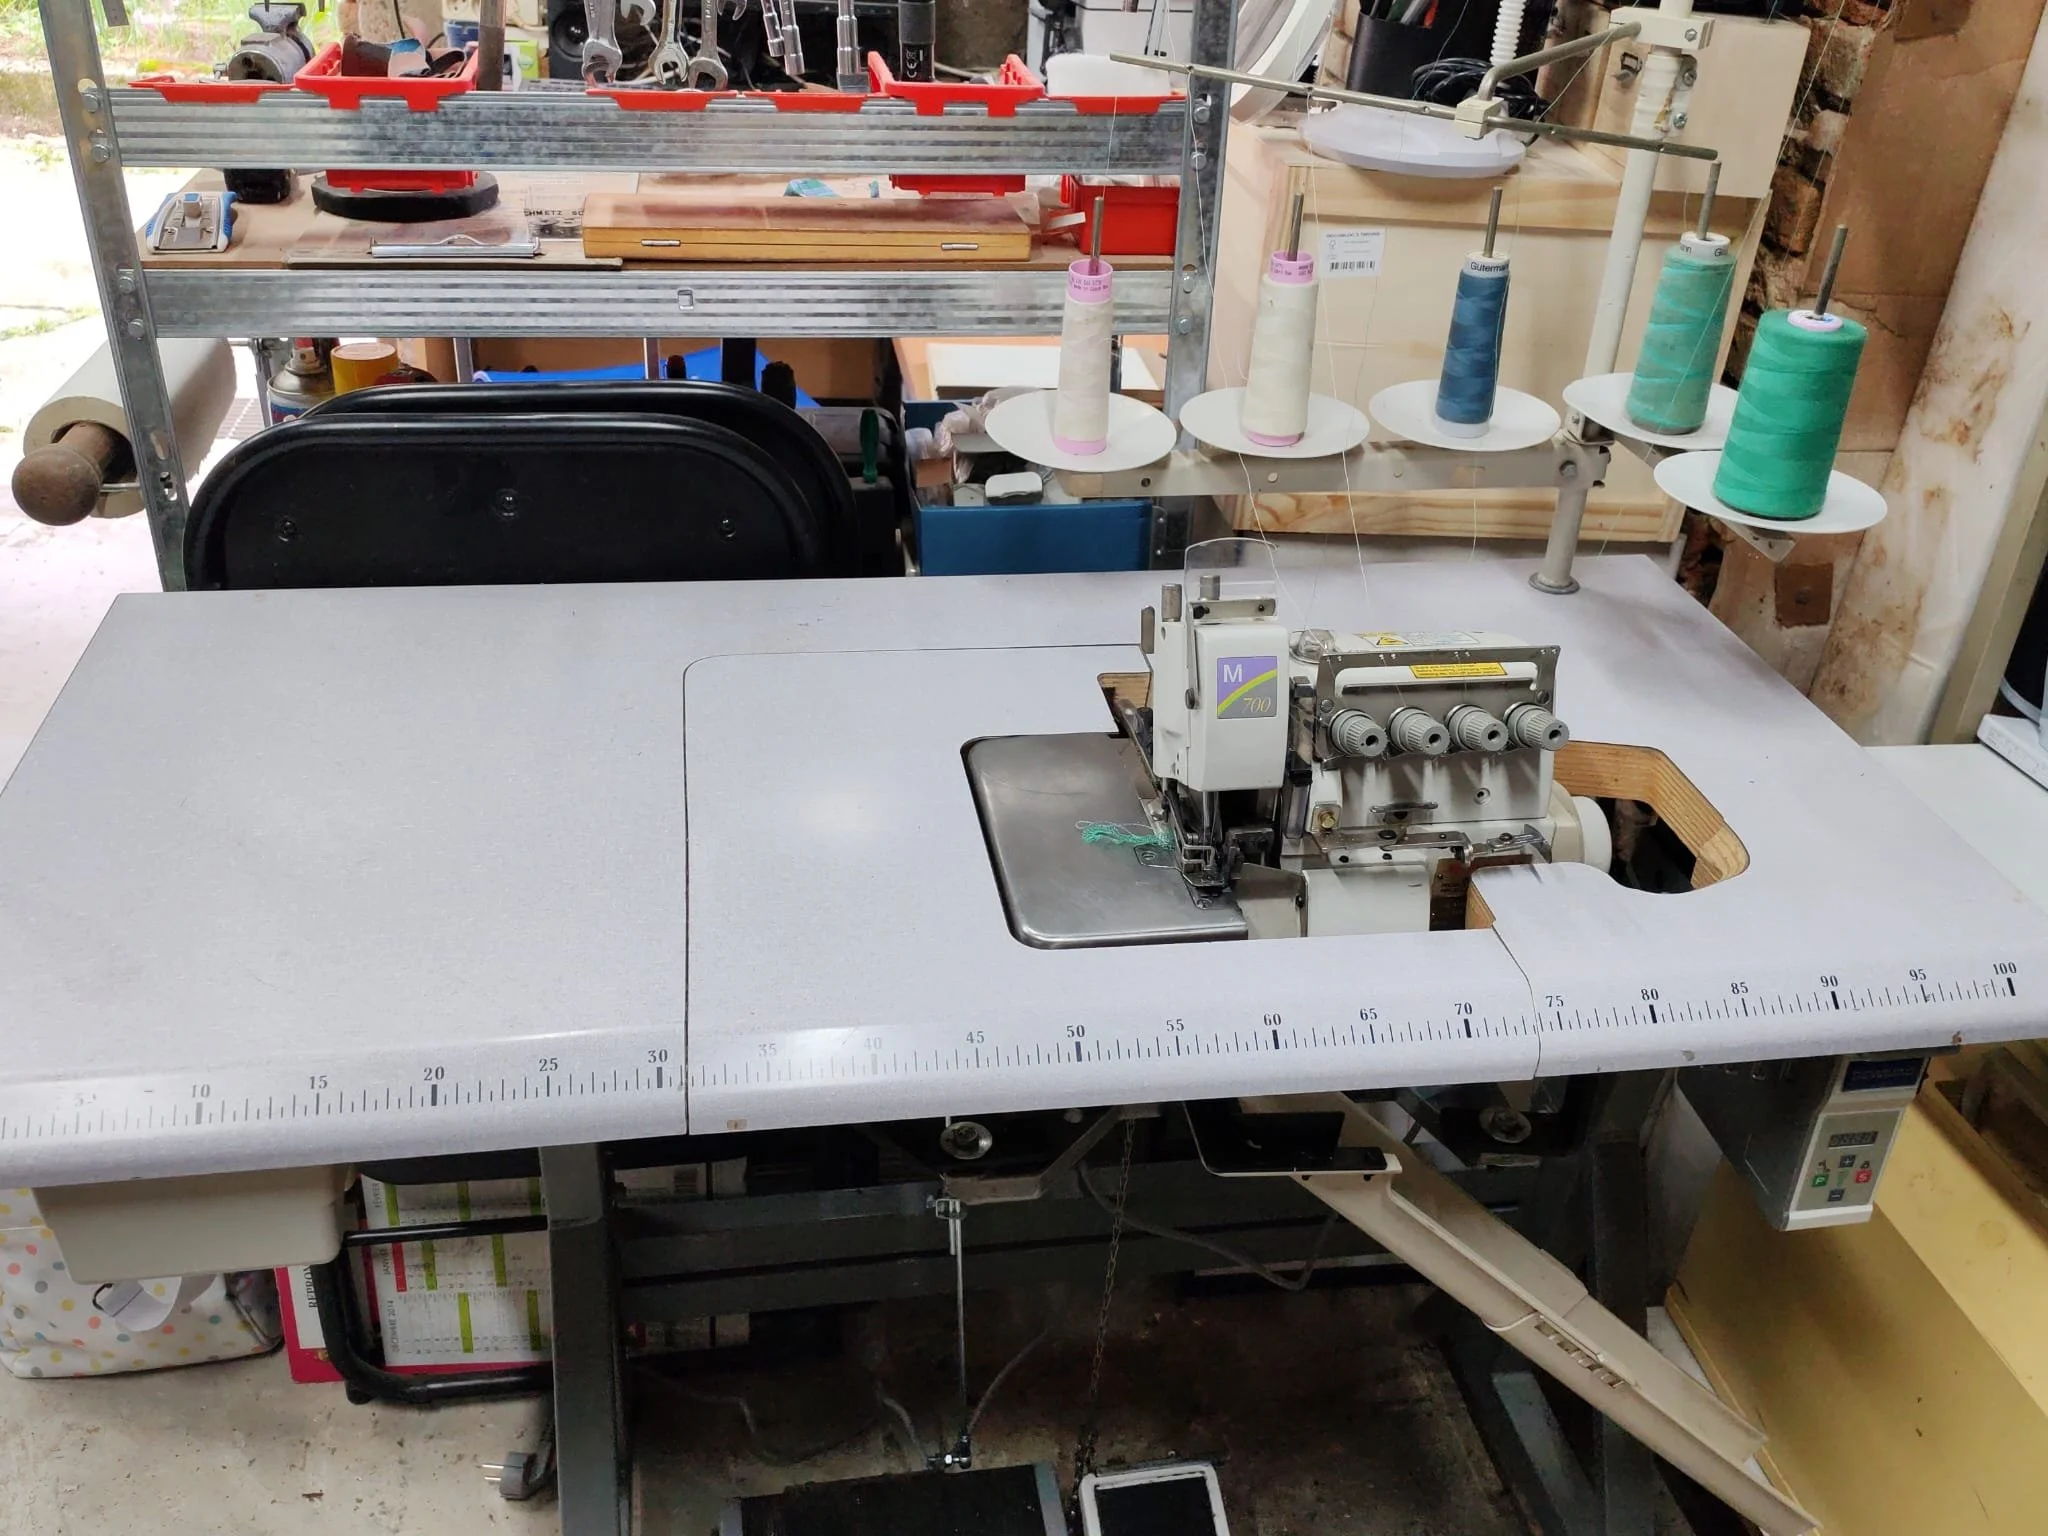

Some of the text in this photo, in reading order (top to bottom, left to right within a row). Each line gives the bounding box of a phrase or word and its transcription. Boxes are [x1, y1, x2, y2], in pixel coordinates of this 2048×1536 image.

[1223, 663, 1243, 683] M
[1241, 696, 1272, 713] 700
[190, 1083, 211, 1099] 10
[308, 1074, 329, 1090] 15
[423, 1065, 445, 1082] 20
[538, 1056, 559, 1073] 25
[647, 1049, 669, 1064] 30
[757, 1043, 778, 1058] 35
[863, 1036, 883, 1051] 40
[965, 1030, 986, 1045] 45
[1066, 1024, 1086, 1039] 50
[1165, 1018, 1186, 1033] 55
[1262, 1012, 1282, 1027] 60
[1359, 1007, 1378, 1022] 65
[1453, 1001, 1473, 1016] 70
[1545, 994, 1565, 1008] 75
[1640, 987, 1660, 1001] 80
[1730, 981, 1750, 995] 85
[1819, 974, 1839, 988] 90
[1908, 968, 1928, 982] 95
[1992, 961, 2018, 976] 100
